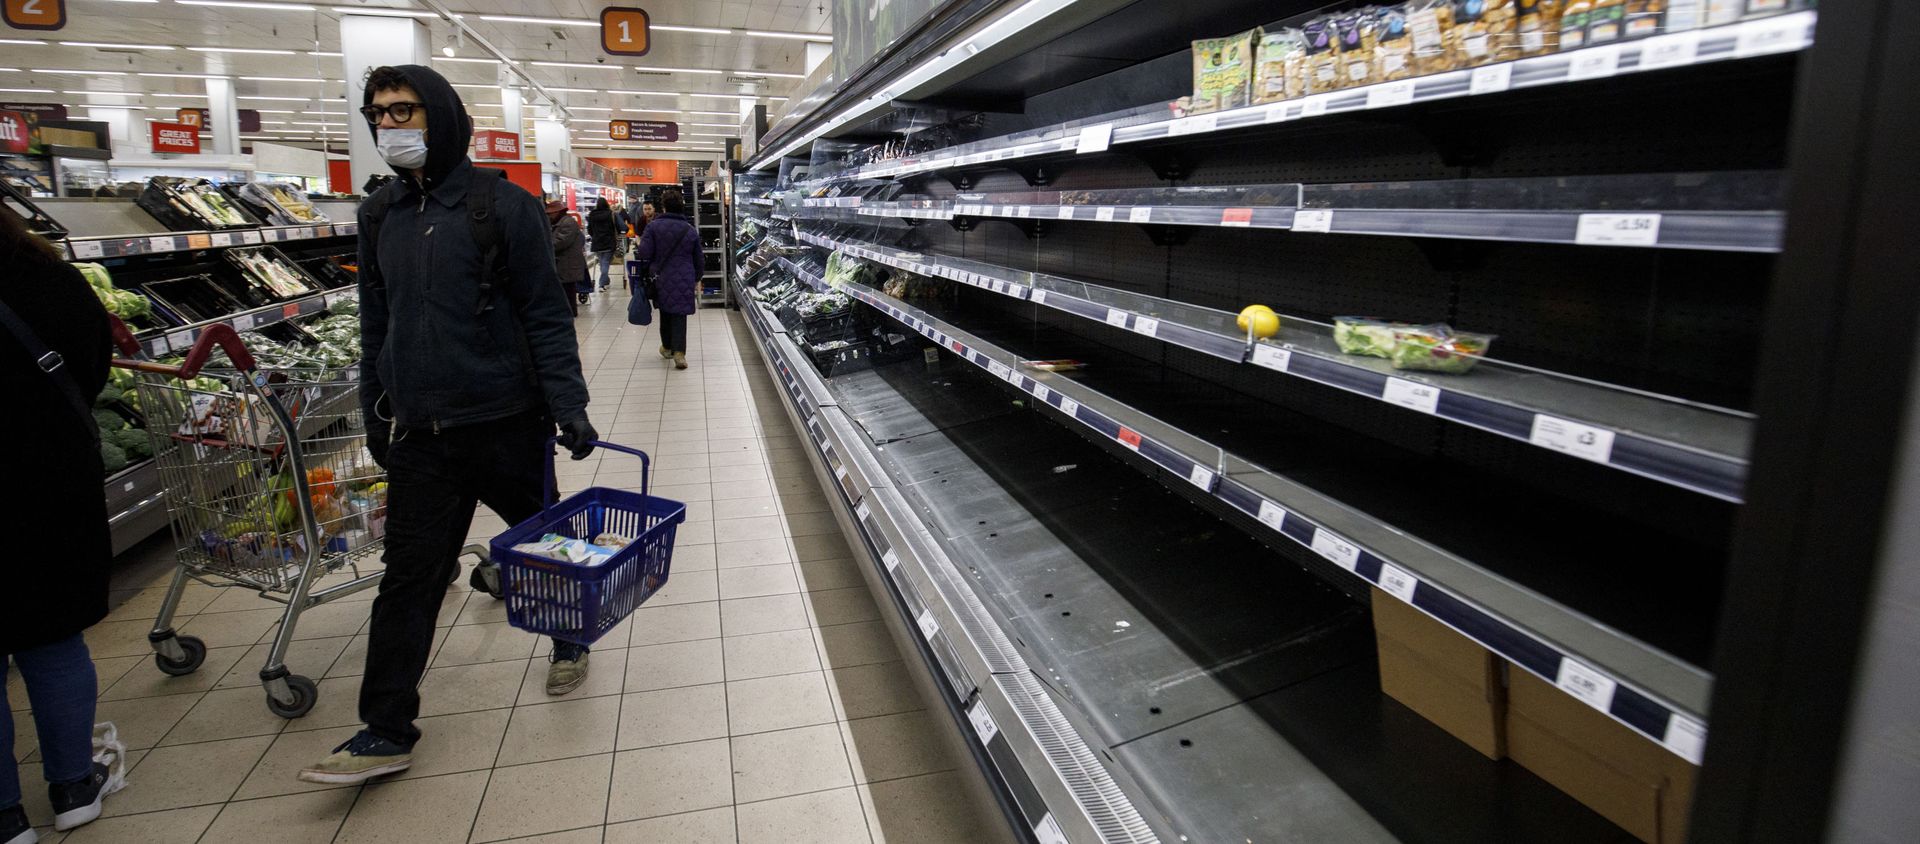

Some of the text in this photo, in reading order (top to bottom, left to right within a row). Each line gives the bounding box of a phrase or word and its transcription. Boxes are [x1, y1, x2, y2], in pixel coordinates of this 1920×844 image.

[618, 20, 632, 43] 1
[181, 114, 198, 125] 17
[160, 129, 192, 139] GREAT
[613, 125, 627, 135] 19
[159, 137, 195, 147] PRICES
